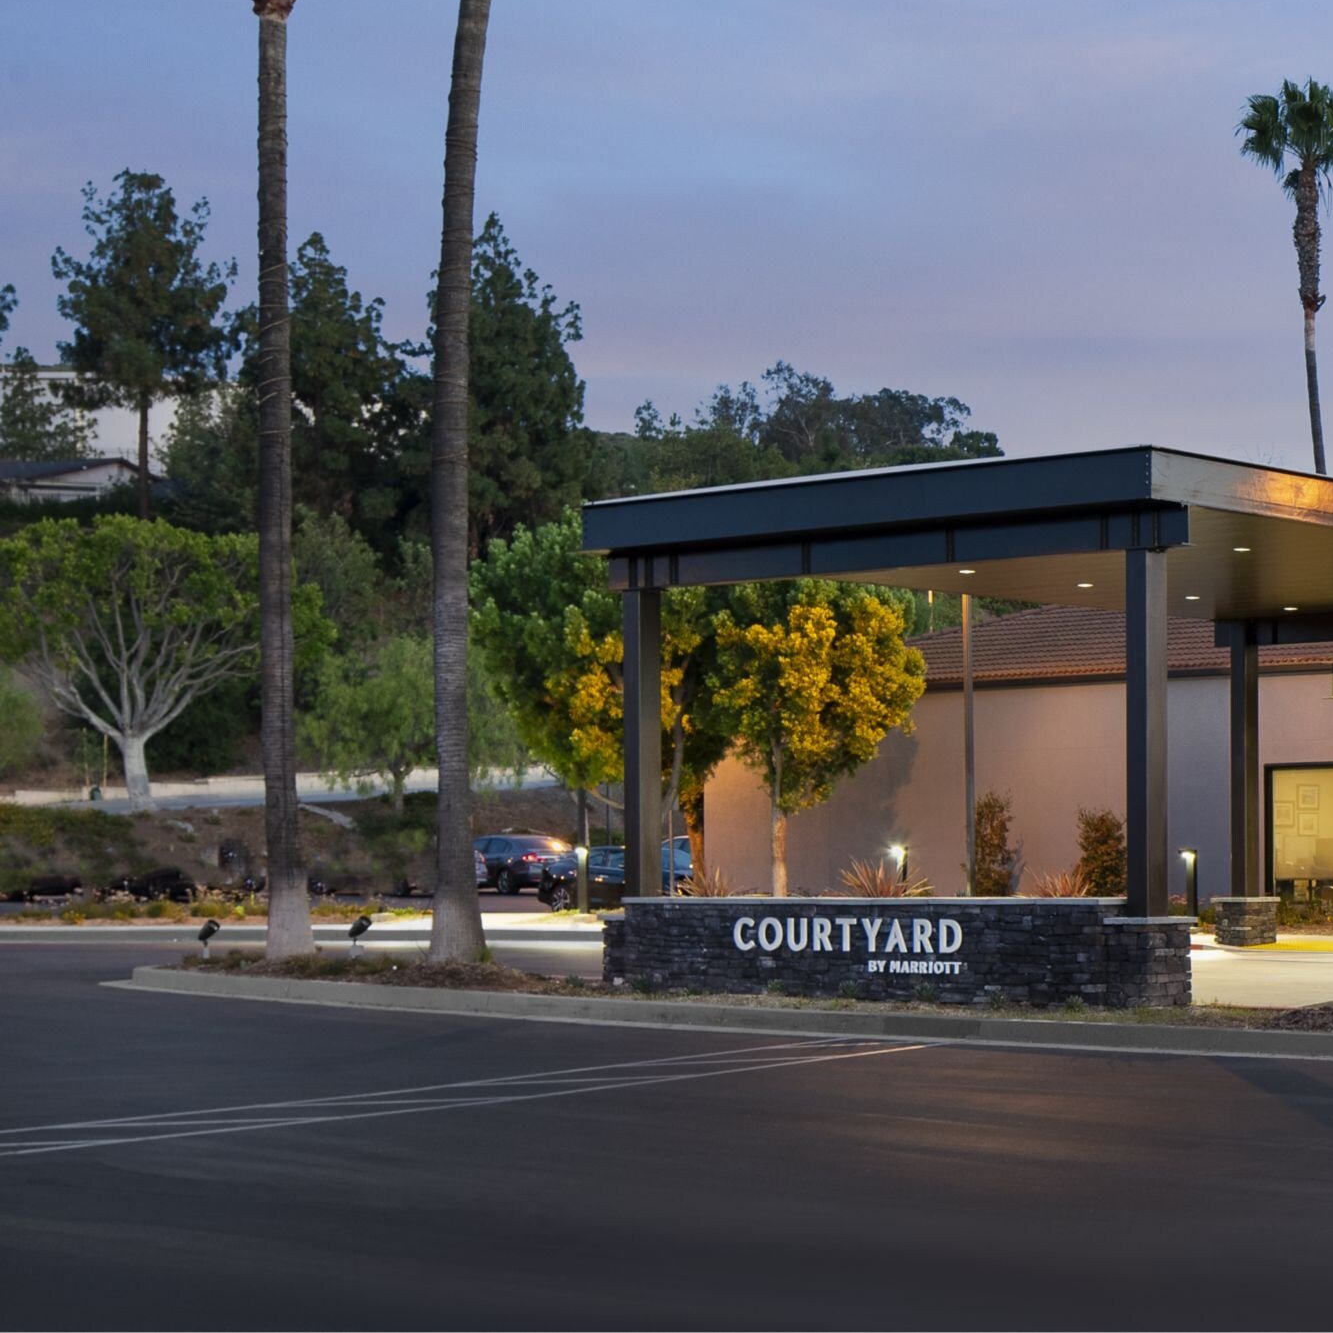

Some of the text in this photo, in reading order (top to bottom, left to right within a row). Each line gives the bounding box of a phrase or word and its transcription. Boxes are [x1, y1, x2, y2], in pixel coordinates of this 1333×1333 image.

[733, 916, 963, 954] COURTYARD
[867, 960, 962, 975] BY MARRIOTT
